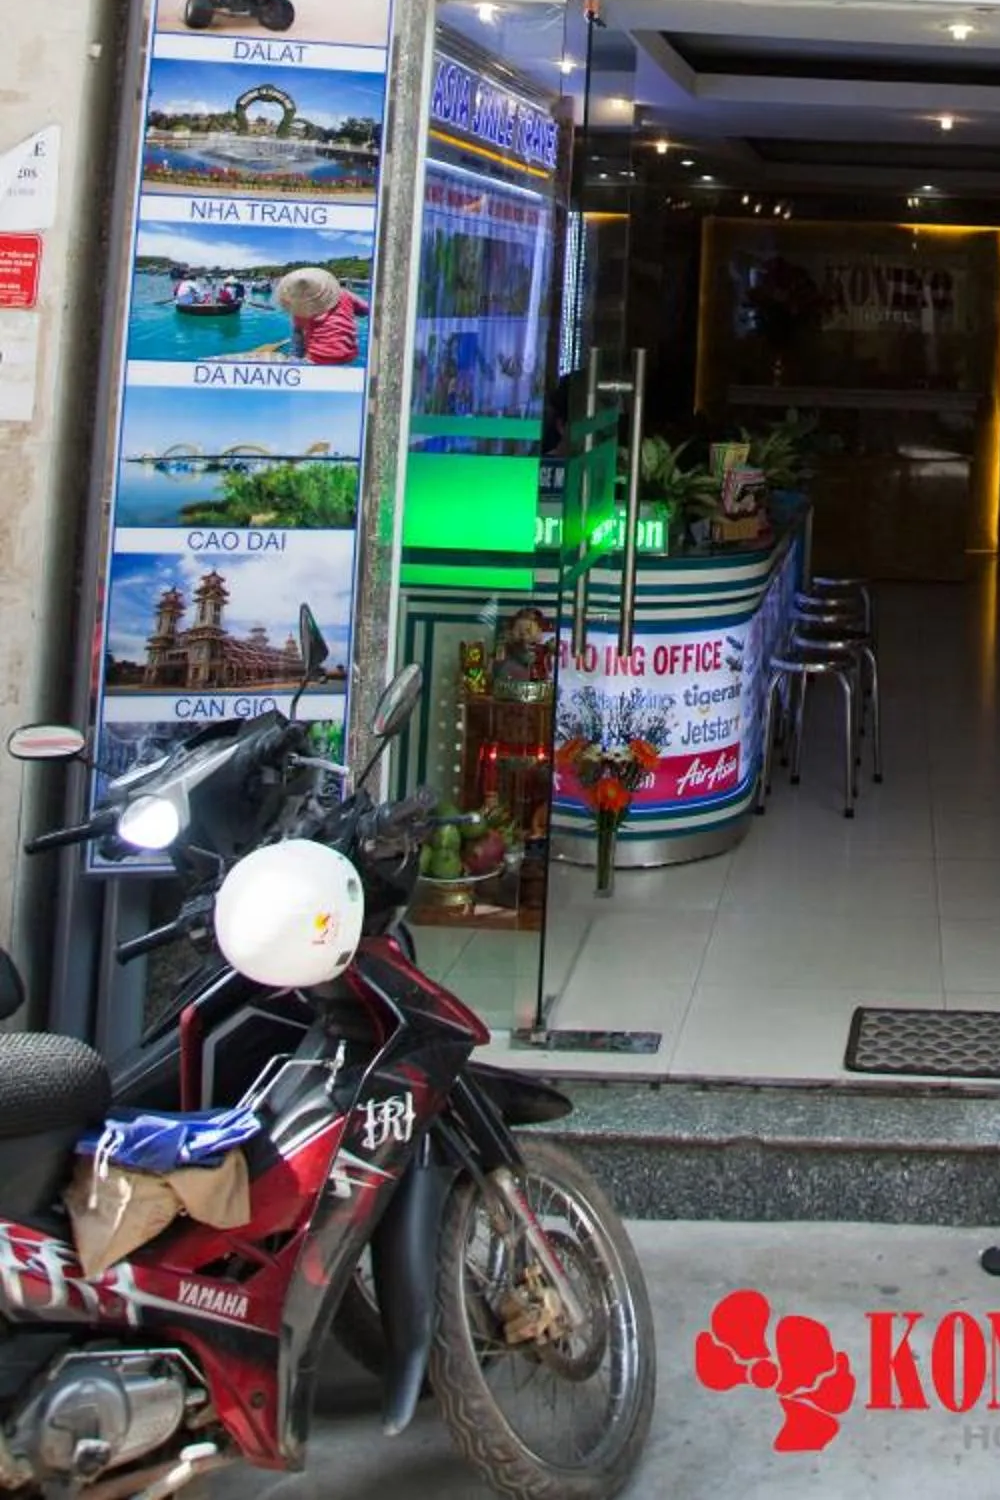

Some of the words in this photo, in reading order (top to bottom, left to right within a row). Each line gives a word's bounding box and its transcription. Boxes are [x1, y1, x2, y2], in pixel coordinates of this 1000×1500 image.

[232, 40, 309, 64] DALAT
[190, 201, 241, 222] NHA
[245, 203, 329, 226] TRANG
[193, 363, 228, 385] DA
[232, 366, 302, 388] NANG
[187, 531, 240, 552] CAO
[247, 531, 288, 552] DAI
[653, 640, 723, 676] OFFICE
[174, 696, 226, 719] CAN
[233, 697, 279, 719] GIO
[178, 1280, 249, 1319] YAMAHA
